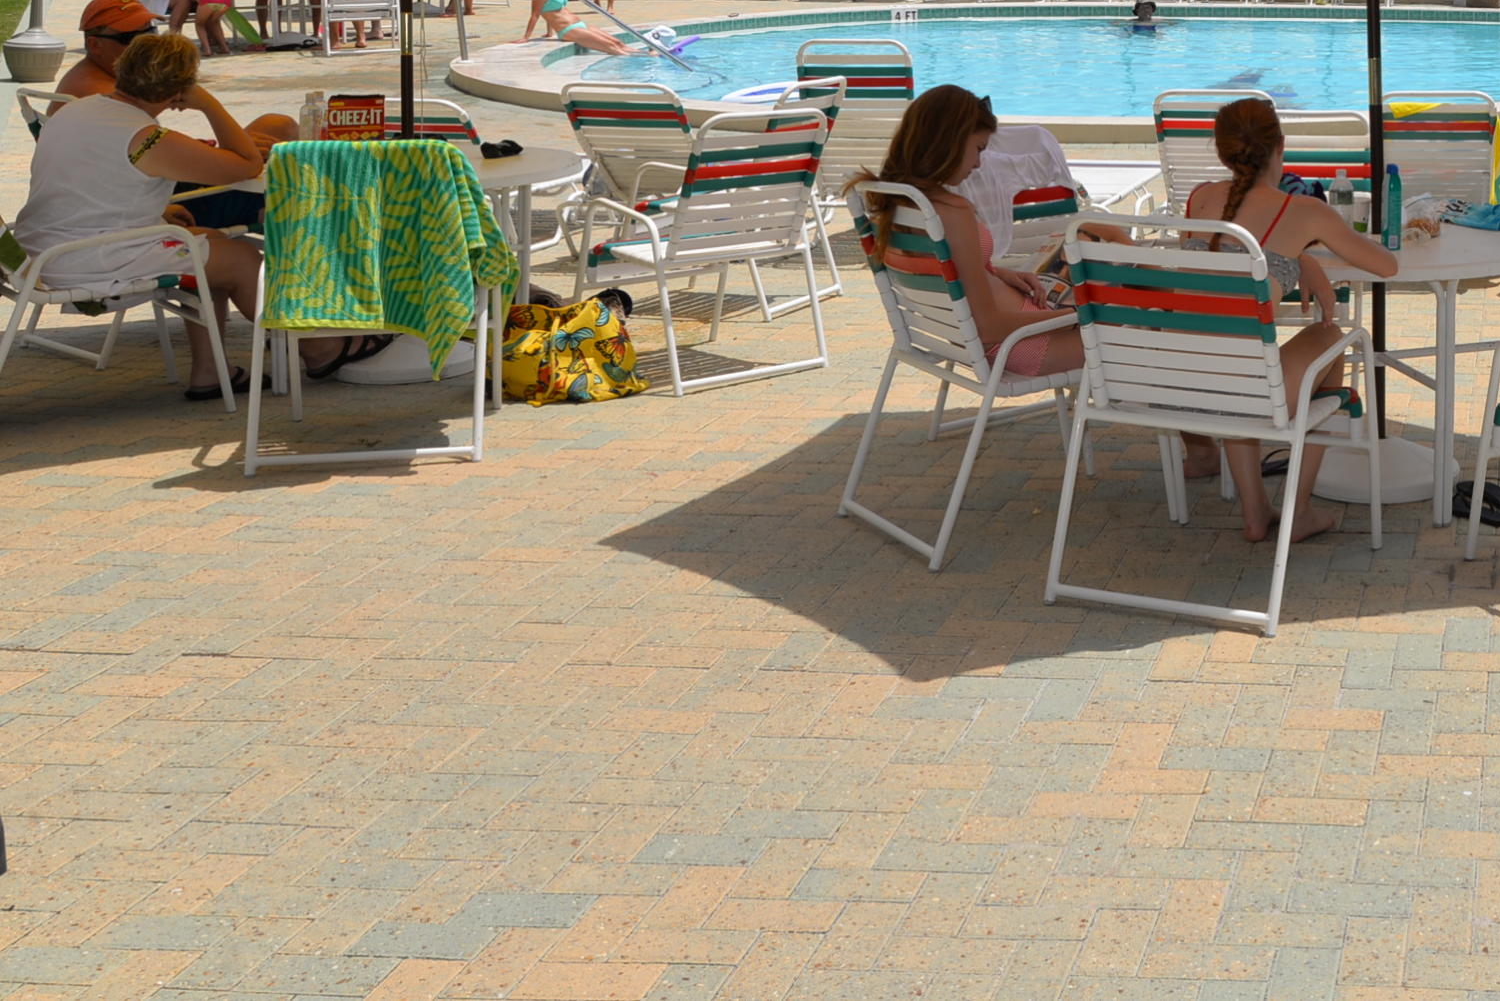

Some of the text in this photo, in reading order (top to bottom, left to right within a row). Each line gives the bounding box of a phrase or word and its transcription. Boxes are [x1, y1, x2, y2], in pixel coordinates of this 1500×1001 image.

[895, 10, 917, 21] 4 FT
[329, 109, 383, 126] CHEEZ-IT
